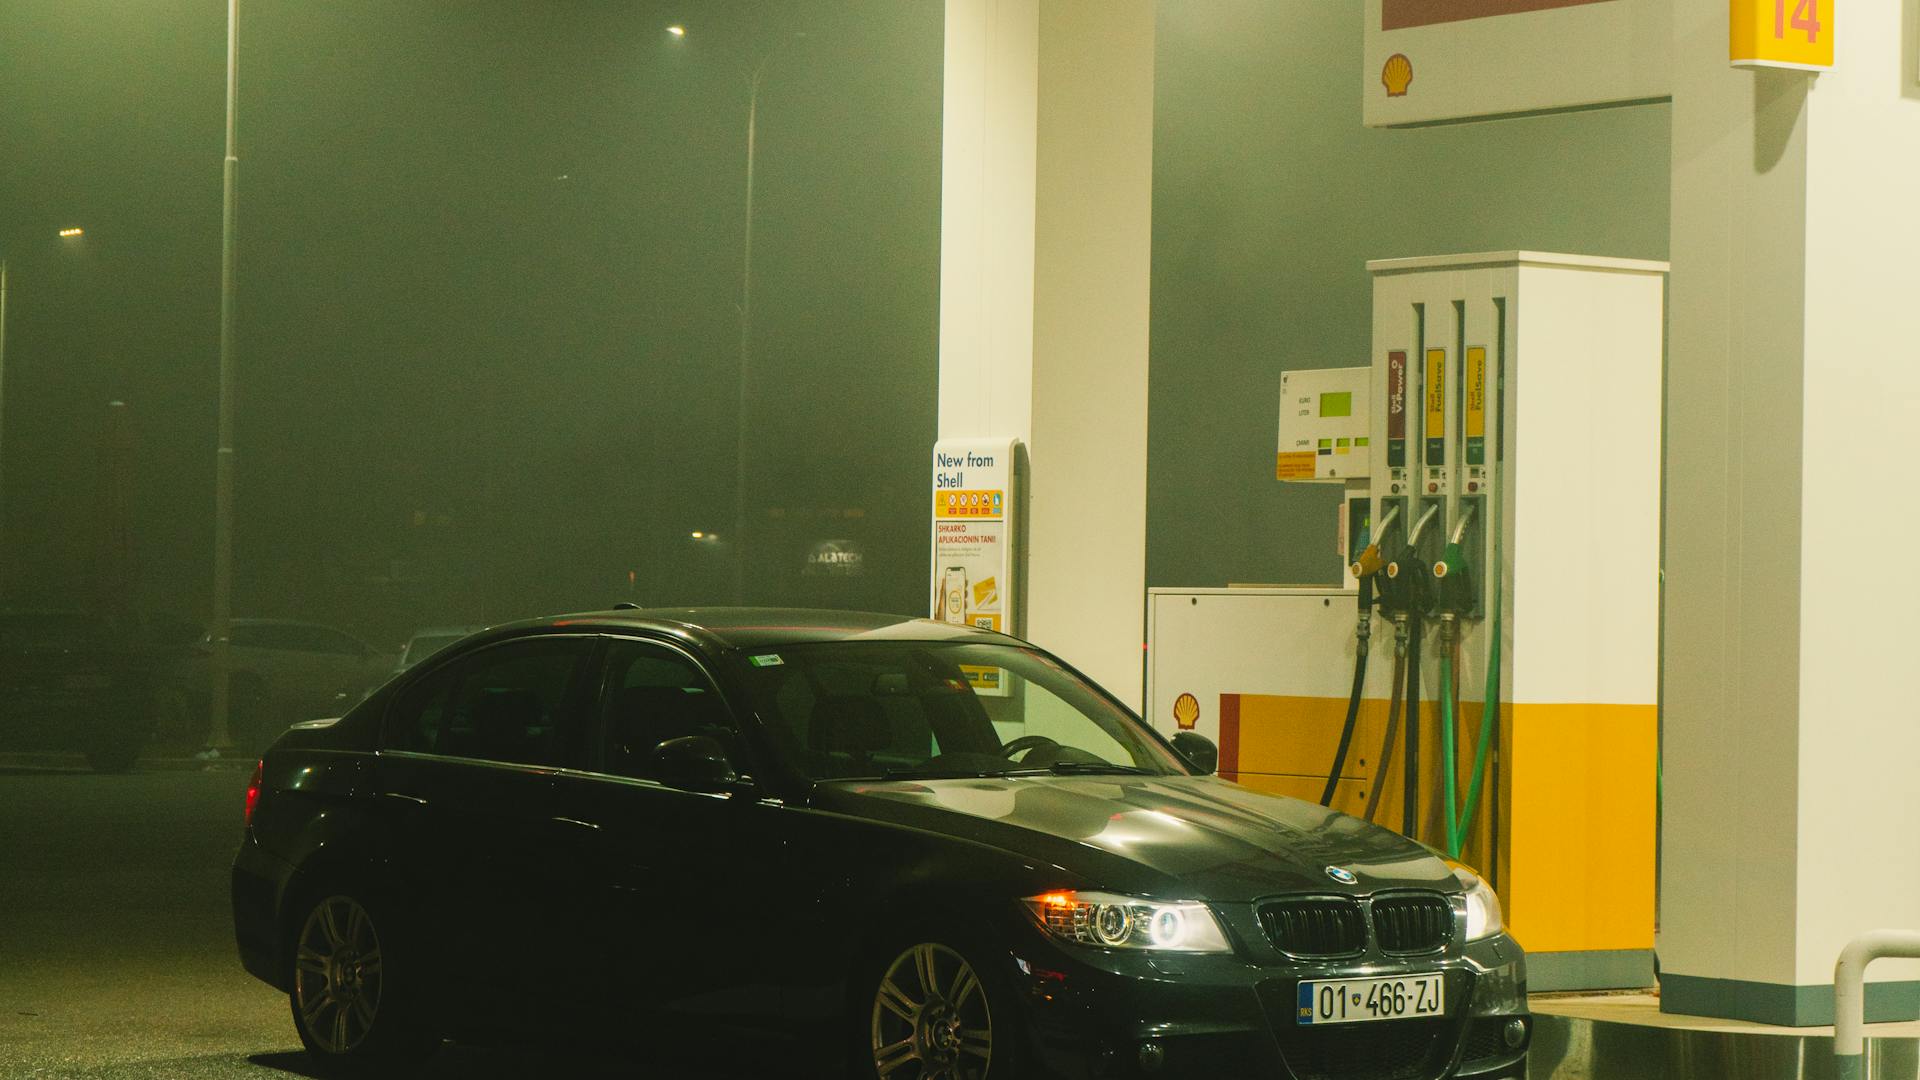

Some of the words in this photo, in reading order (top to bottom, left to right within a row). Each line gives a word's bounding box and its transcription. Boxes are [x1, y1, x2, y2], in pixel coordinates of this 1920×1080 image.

[1775, 0, 1821, 43] 14
[937, 453, 964, 468] New
[967, 451, 994, 467] from
[937, 472, 963, 488] Shell
[938, 524, 966, 533] SHKARKO
[938, 535, 979, 544] APLIKACIONIN
[1300, 1007, 1312, 1017] RKS
